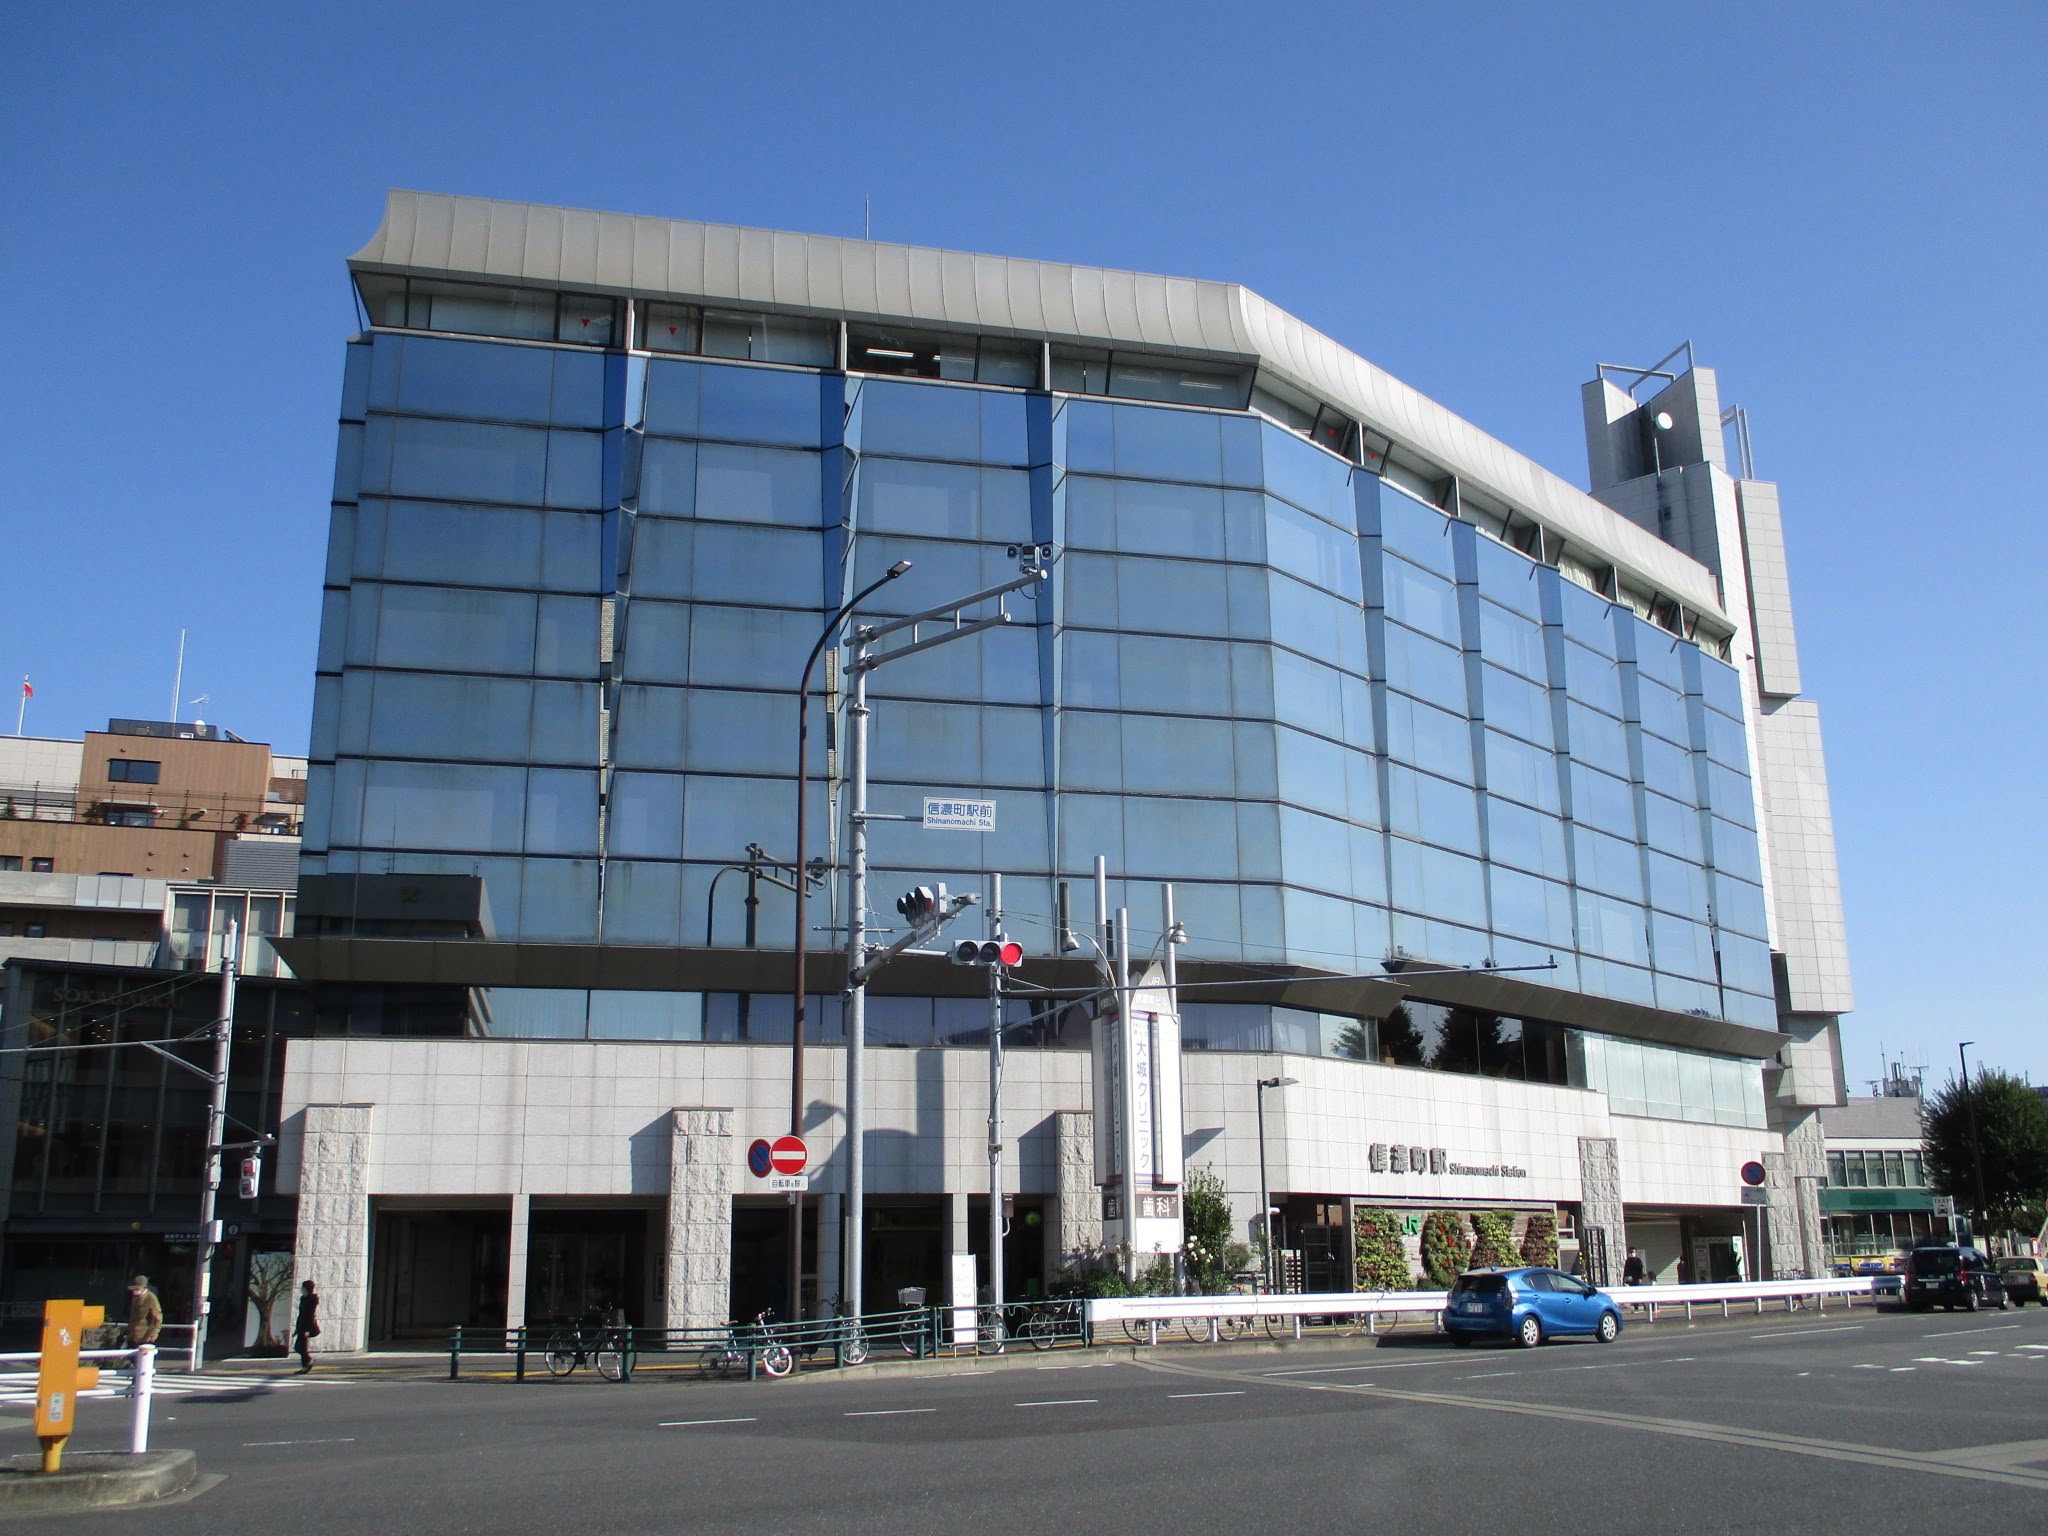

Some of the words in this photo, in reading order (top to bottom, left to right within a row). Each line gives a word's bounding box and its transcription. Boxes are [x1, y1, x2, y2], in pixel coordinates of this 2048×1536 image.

[928, 803, 992, 818] 信濃町駅前
[927, 817, 976, 826] Shinanomachi
[978, 819, 992, 827] Sta.
[1148, 976, 1160, 985] JR
[1136, 1040, 1149, 1168] 大城クリニック
[1368, 1143, 1447, 1175] 信濃町駅
[1449, 1163, 1499, 1177] Shinanomachi
[1500, 1165, 1527, 1178] Station
[1142, 1196, 1171, 1217] 歯科
[1401, 1215, 1420, 1235] JR
